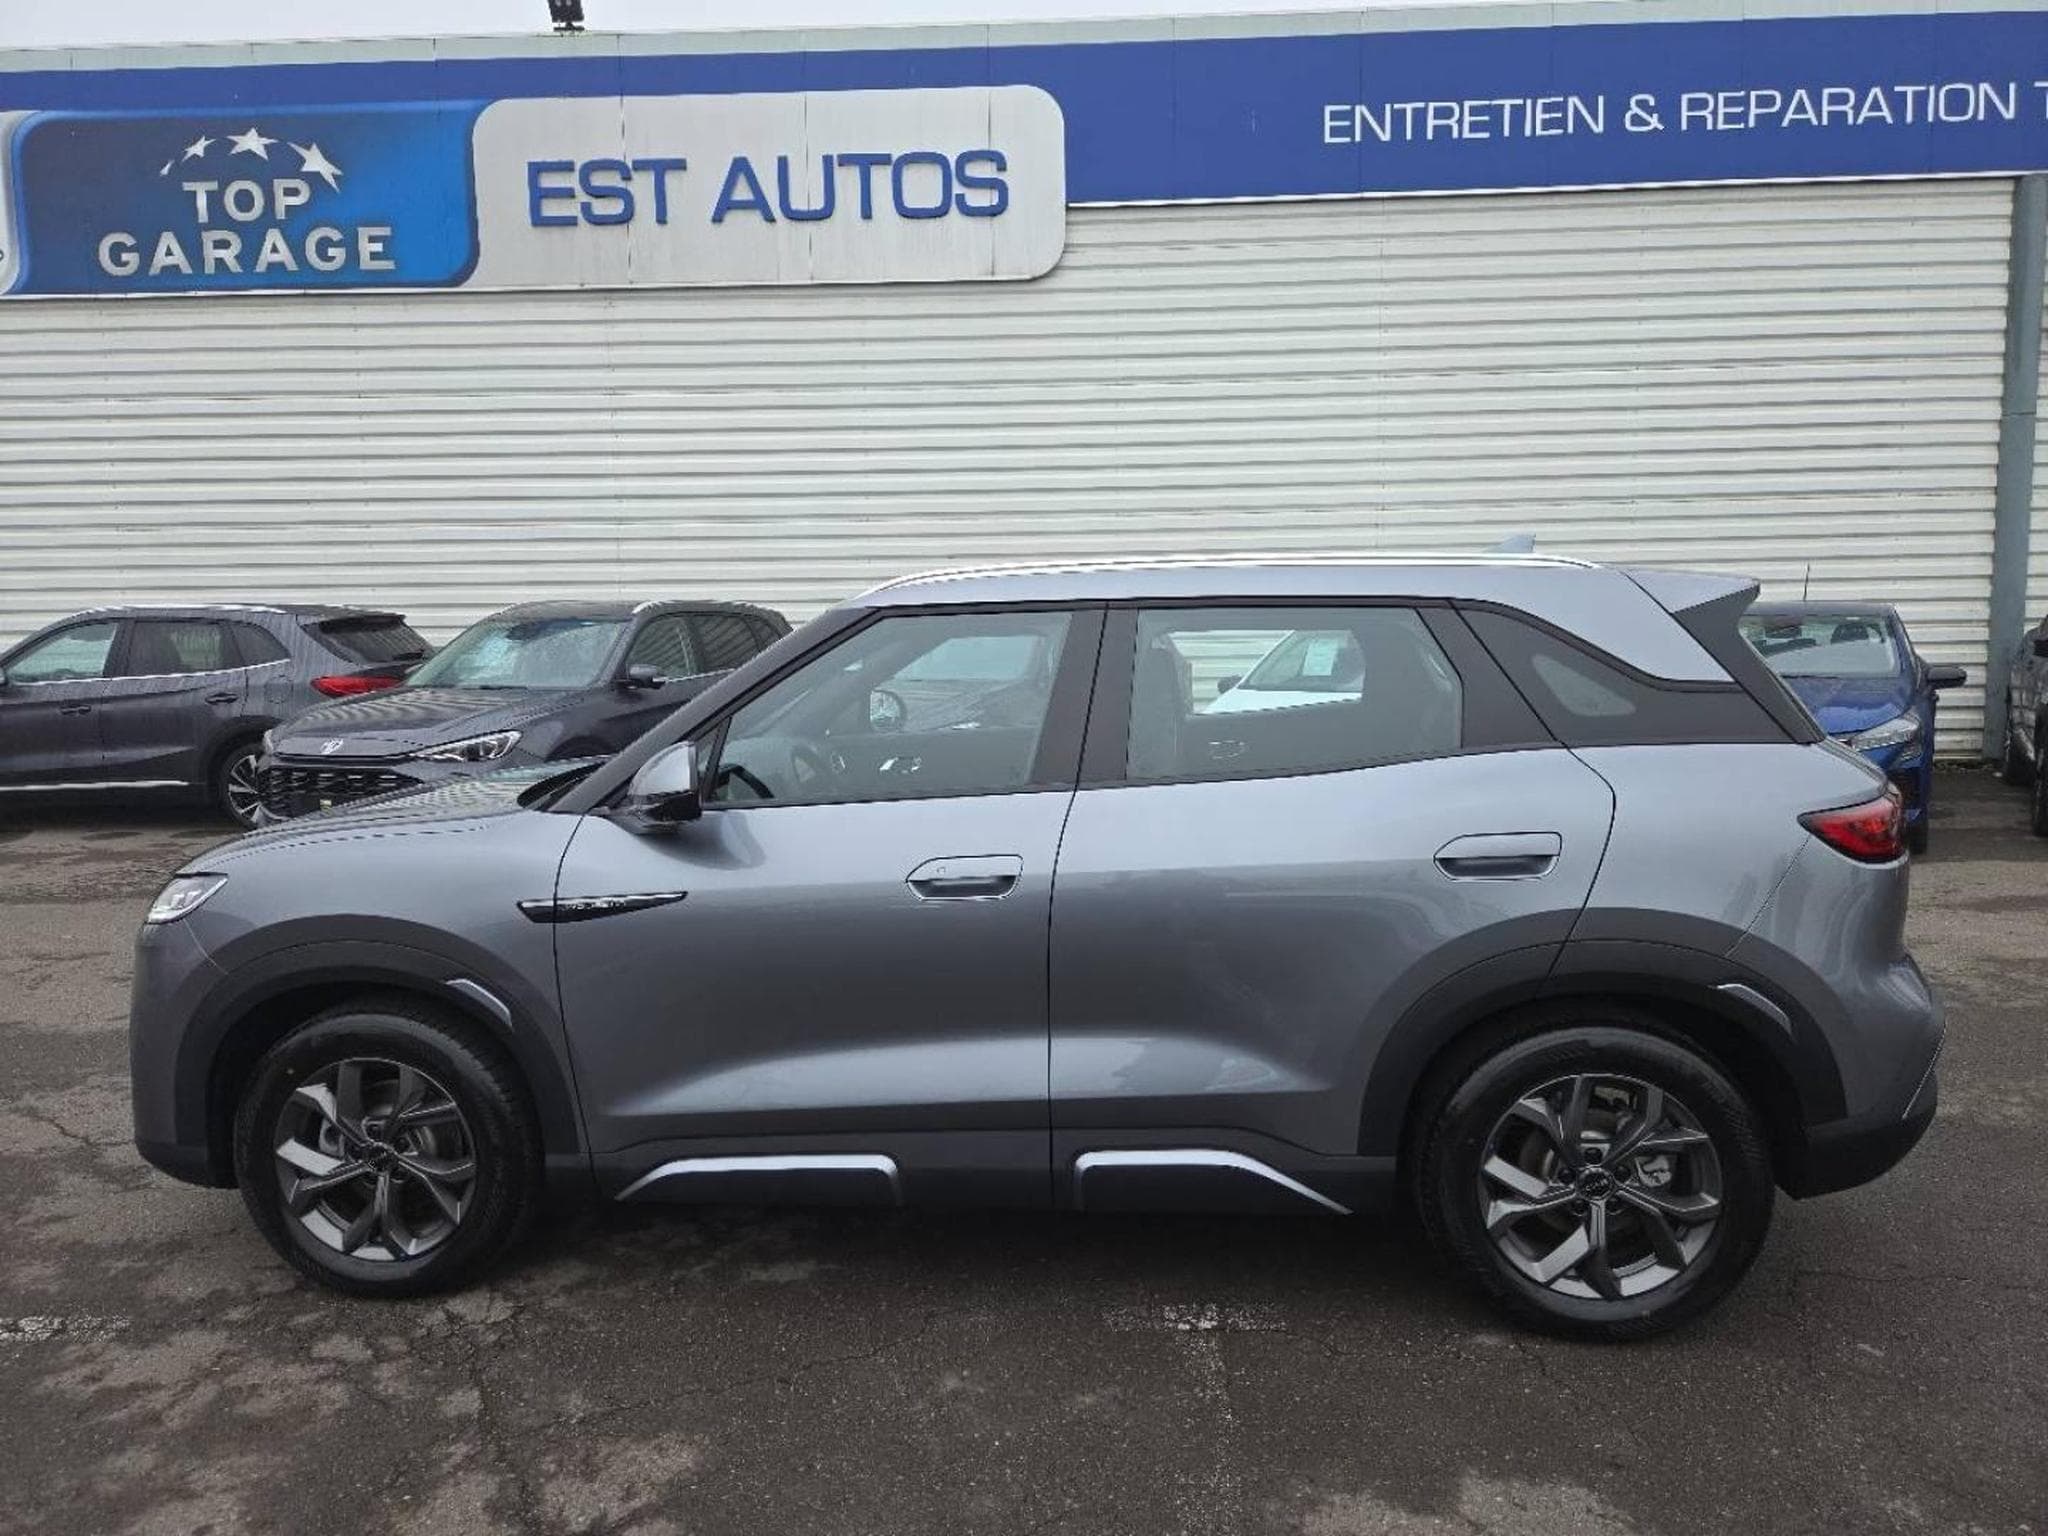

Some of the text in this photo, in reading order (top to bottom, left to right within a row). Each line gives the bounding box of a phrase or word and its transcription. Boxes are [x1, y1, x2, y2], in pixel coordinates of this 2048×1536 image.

[1323, 95, 1605, 144] ENTRETIEN
[1624, 93, 1665, 132] &
[1680, 82, 2016, 131] REPARATION
[182, 178, 312, 223] TOP
[527, 149, 1009, 227] EST AUTOS
[97, 226, 396, 276] GARAGE
